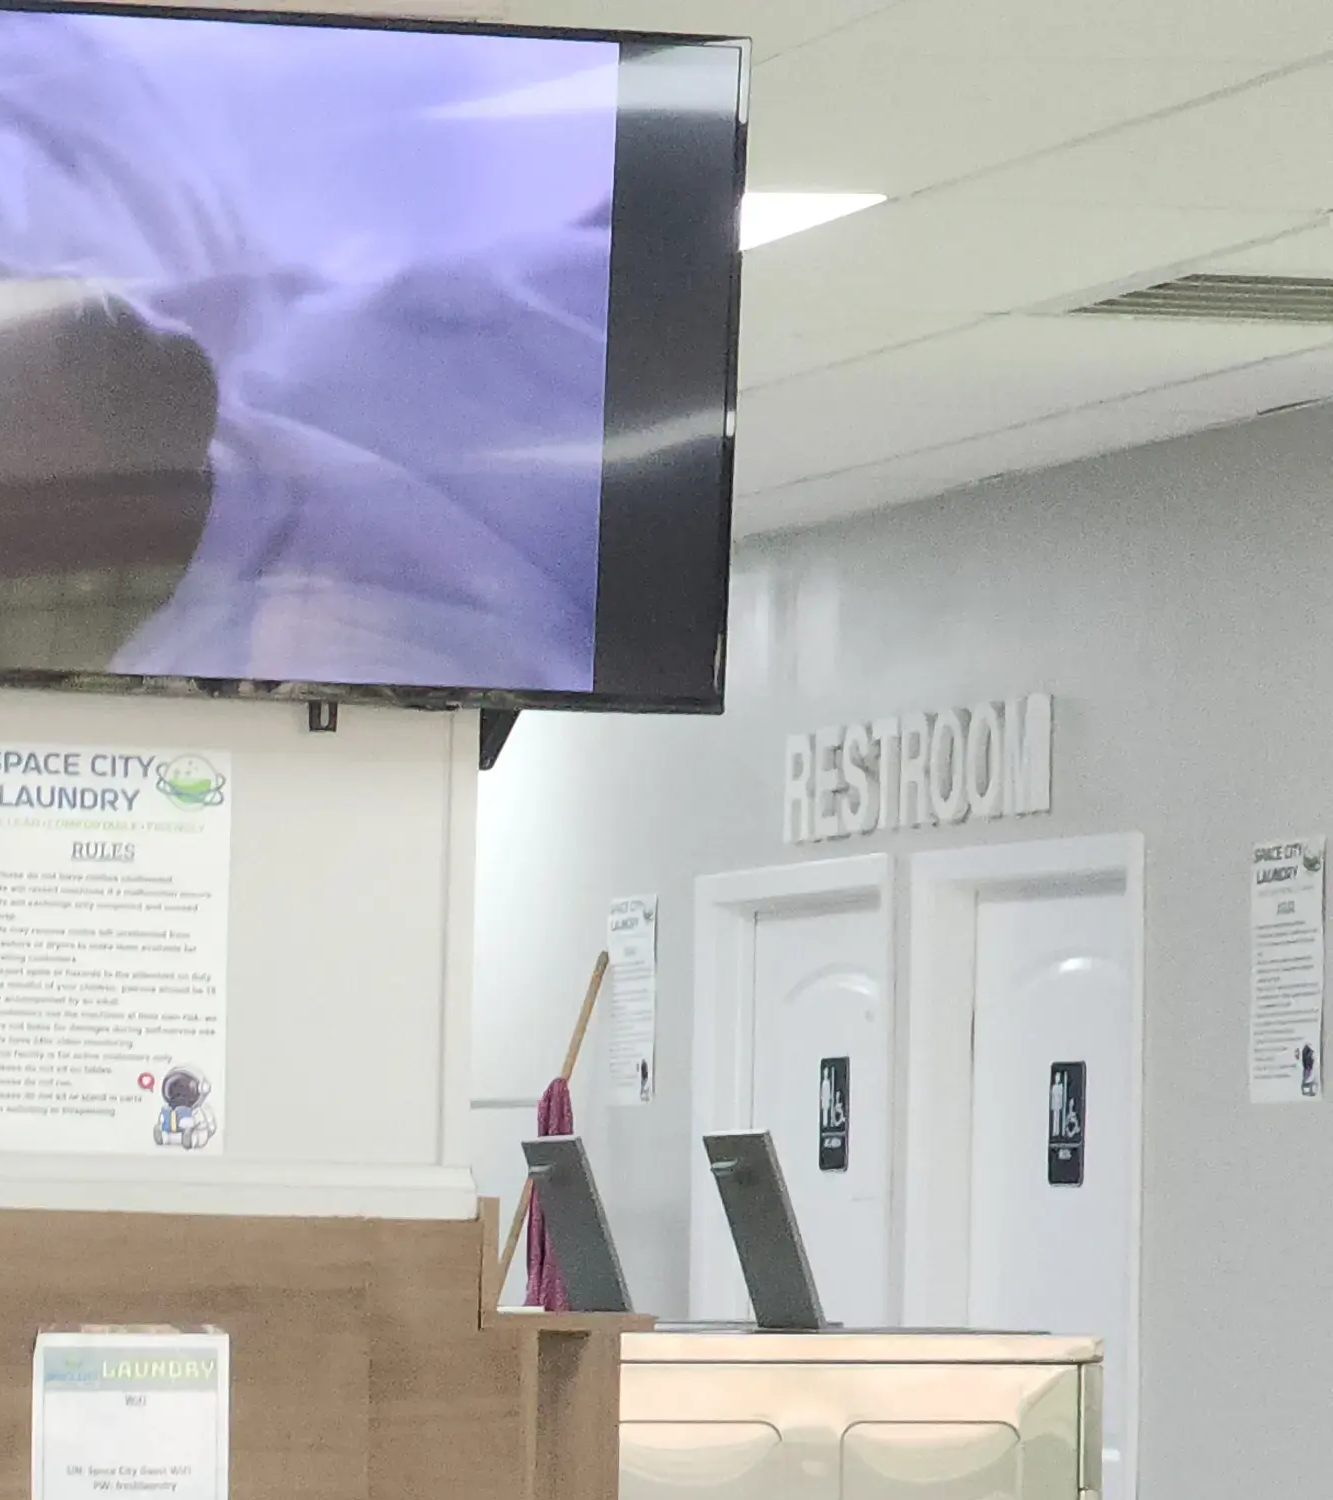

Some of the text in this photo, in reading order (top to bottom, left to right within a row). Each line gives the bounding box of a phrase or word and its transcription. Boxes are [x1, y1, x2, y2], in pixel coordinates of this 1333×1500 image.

[90, 754, 156, 778] CITY
[783, 692, 1054, 844] RESTROOM
[71, 840, 136, 863] RULES
[102, 1360, 215, 1379] LAUNDRY
